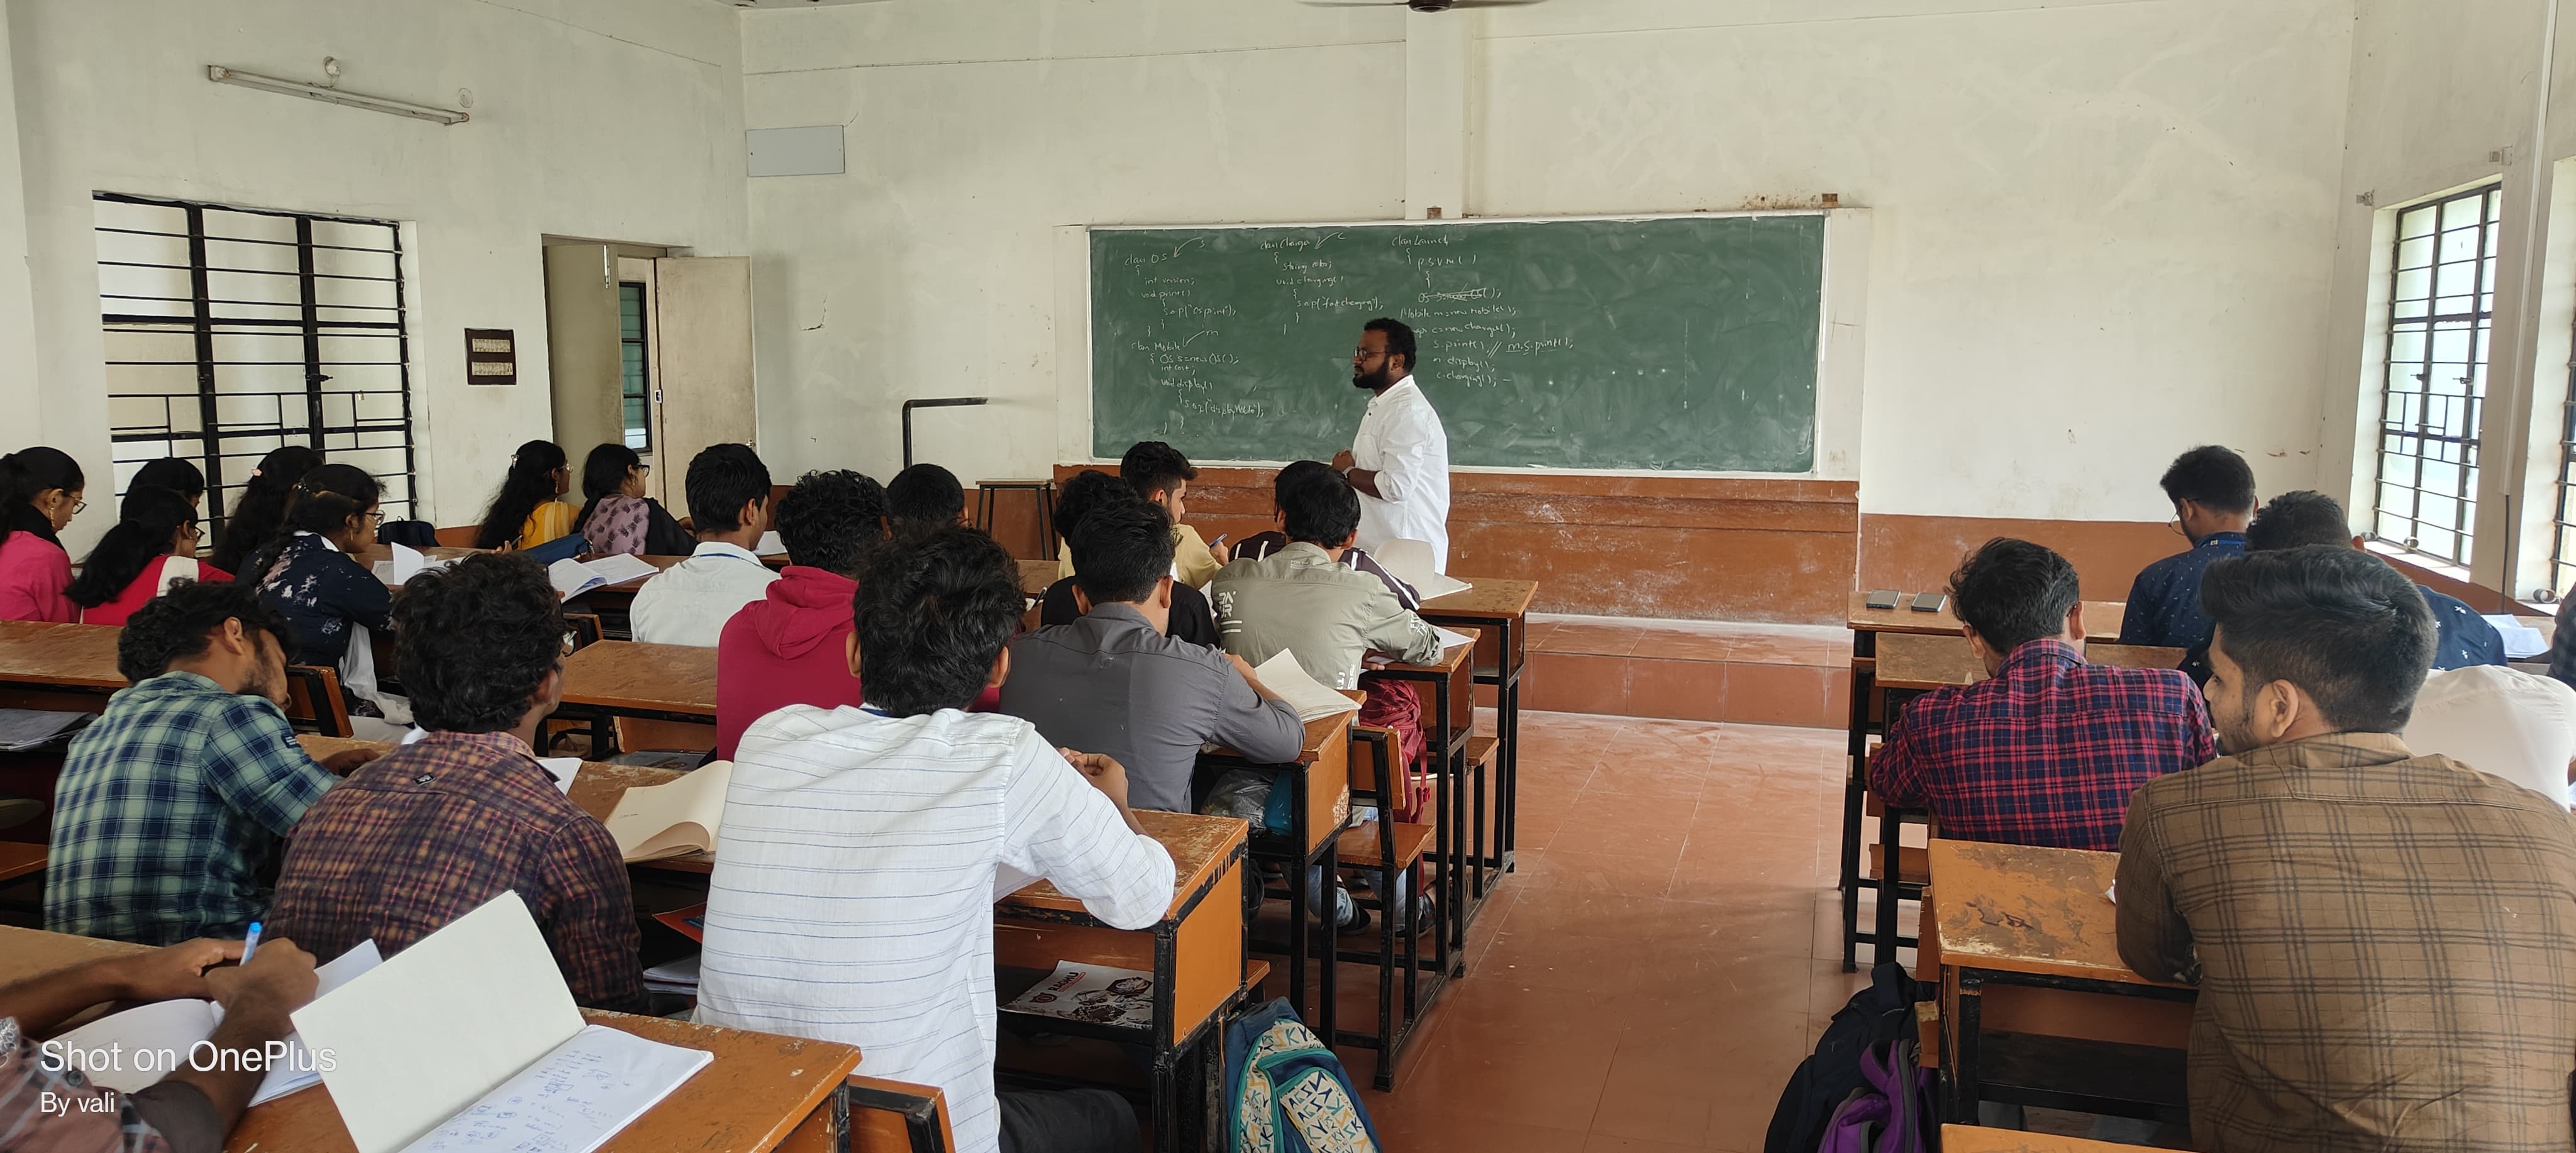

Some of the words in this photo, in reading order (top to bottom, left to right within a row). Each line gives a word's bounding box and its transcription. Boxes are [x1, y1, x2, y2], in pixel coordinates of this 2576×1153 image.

[1151, 253, 1167, 264] OS
[1145, 277, 1157, 285] int
[1161, 378, 1175, 388] void
